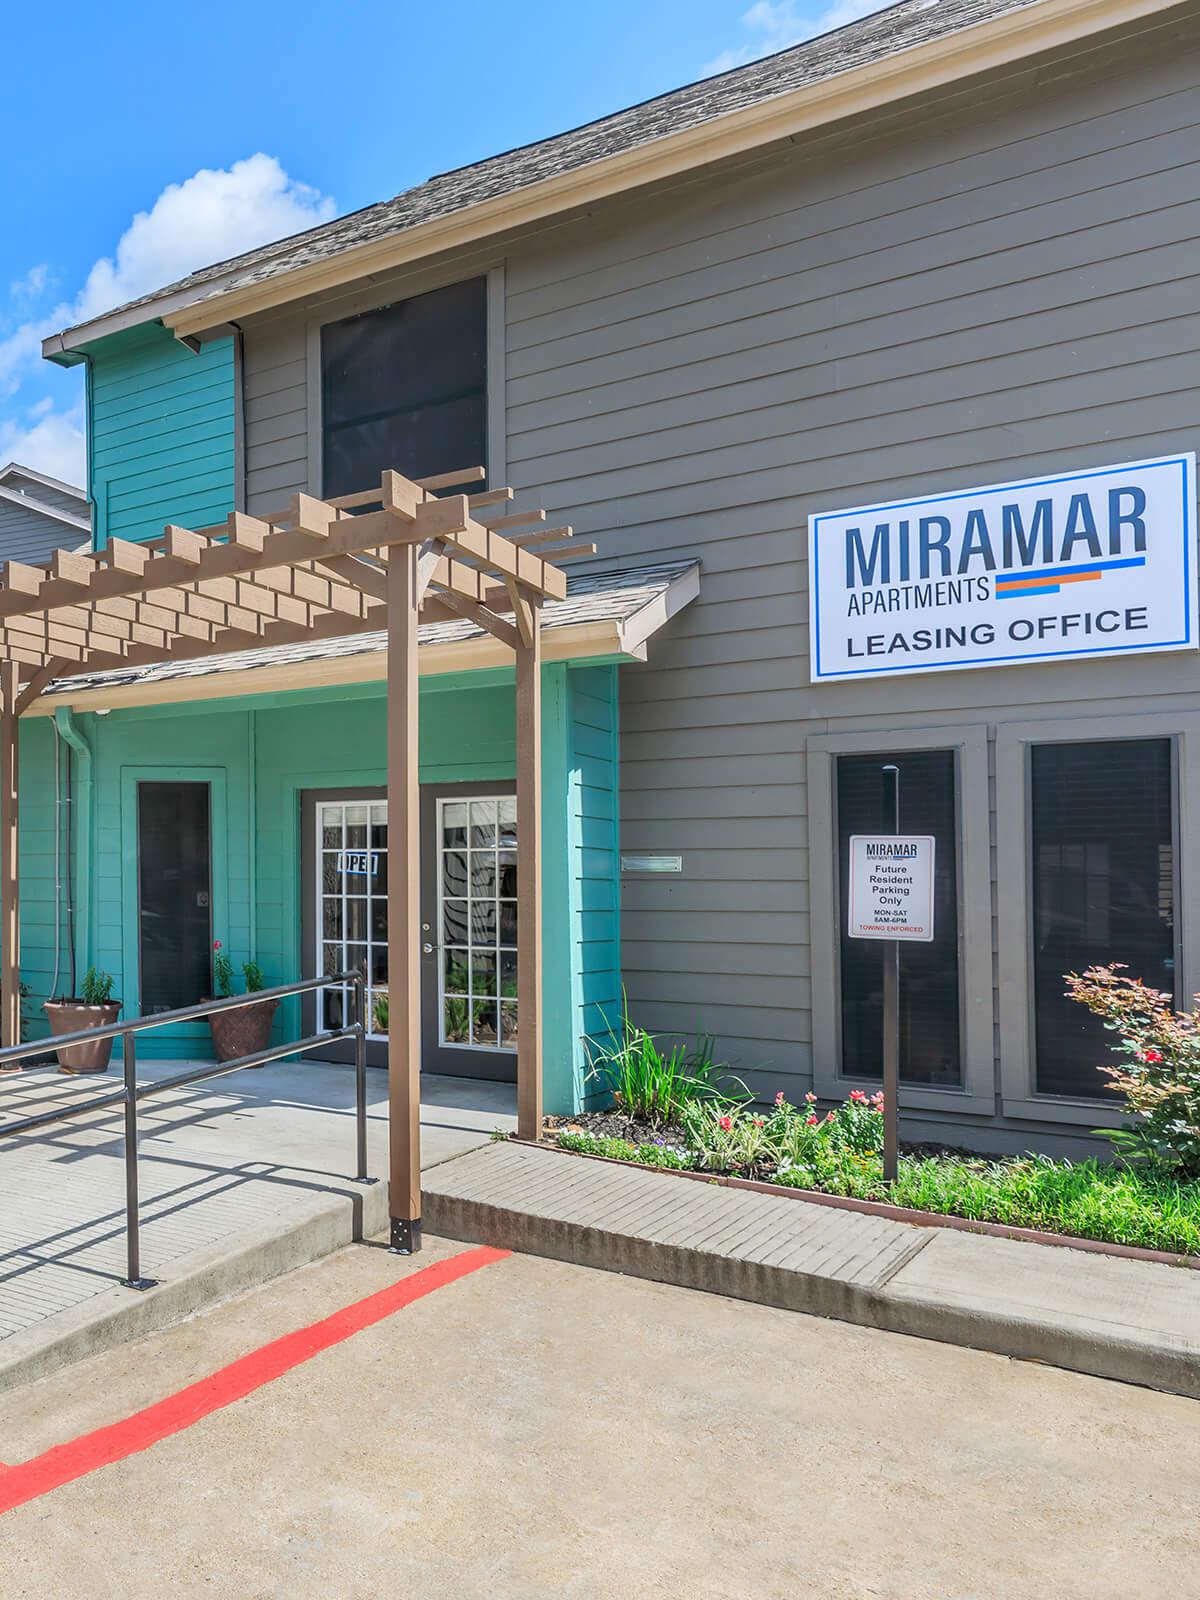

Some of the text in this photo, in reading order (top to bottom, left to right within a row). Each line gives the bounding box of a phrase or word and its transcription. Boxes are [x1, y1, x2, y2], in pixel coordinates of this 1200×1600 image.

[846, 486, 1147, 588] MIRAMAR
[847, 576, 990, 617] APARTMENTS
[847, 607, 1148, 657] LEASING OFFICE
[866, 844, 917, 856] MIRAMAR
[875, 865, 907, 873] Future
[869, 876, 913, 884] Resident
[872, 886, 910, 896] Parking
[879, 896, 902, 906] Only
